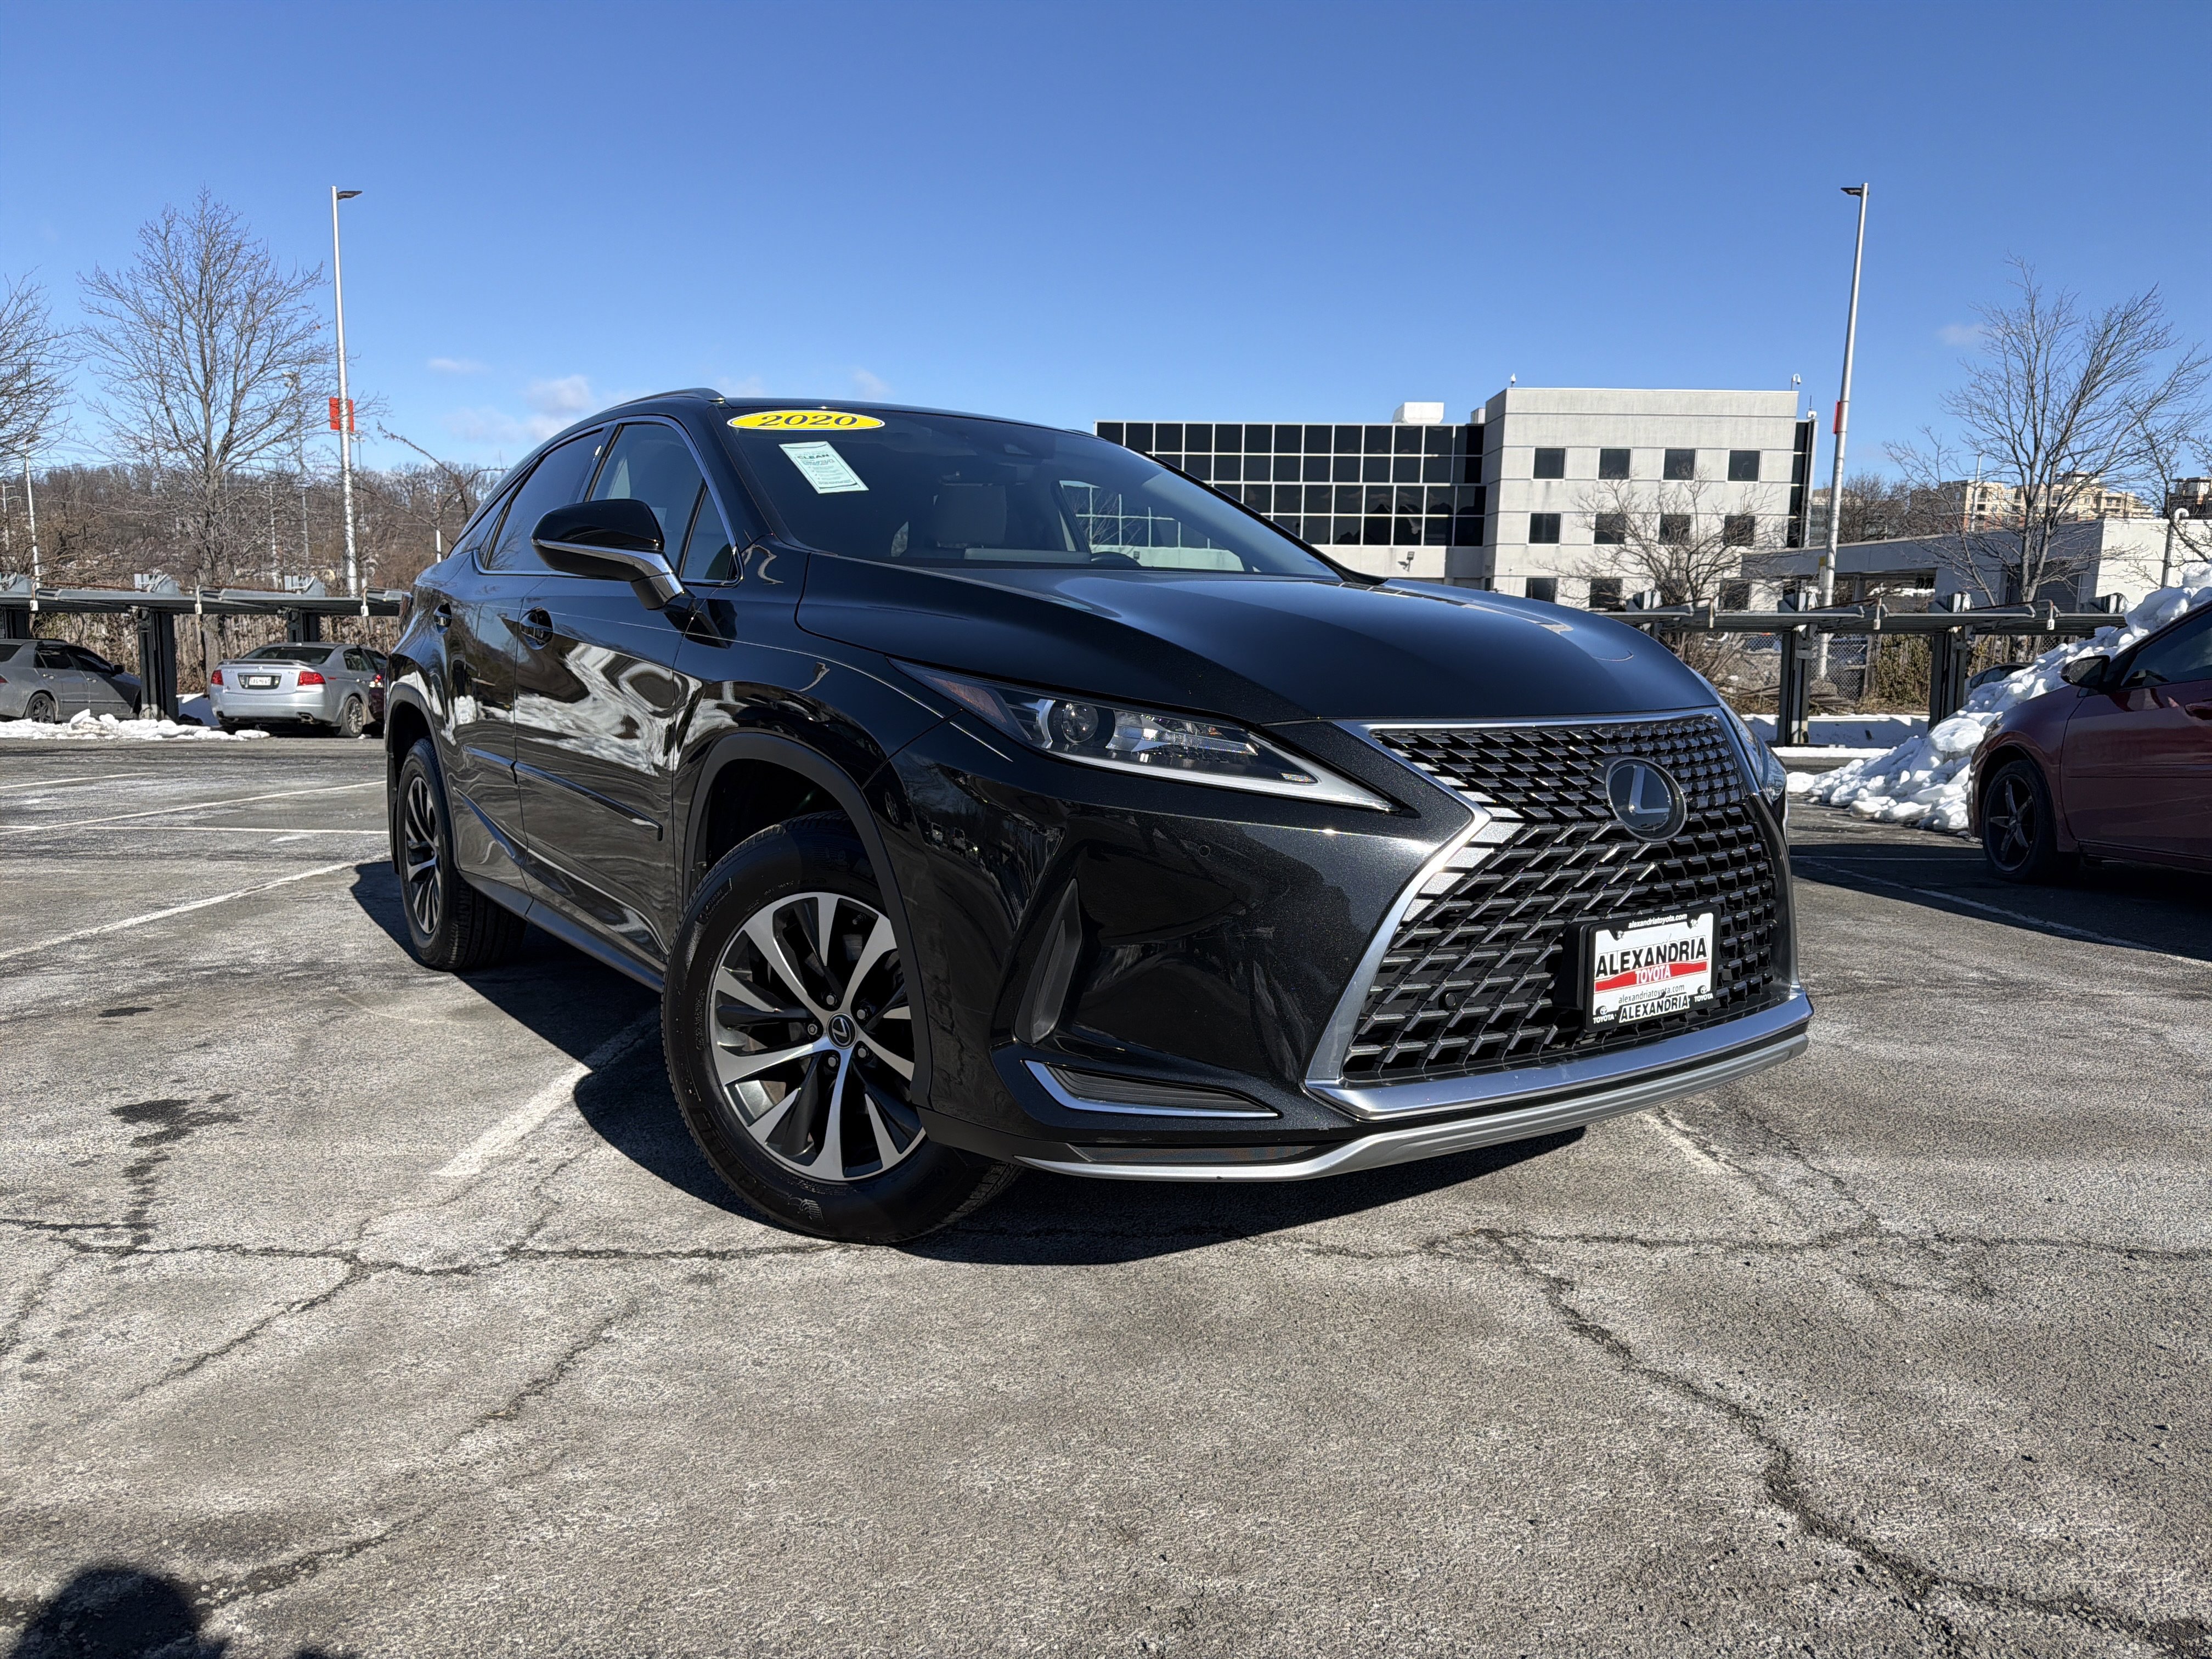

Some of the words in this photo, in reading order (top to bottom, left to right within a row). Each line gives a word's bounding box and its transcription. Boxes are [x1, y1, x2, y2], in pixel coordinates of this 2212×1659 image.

[757, 415, 857, 426] 2020
[1628, 913, 1687, 929] alexandriatoyota.com
[1595, 937, 1707, 978] ALEXANDRIA
[1635, 964, 1671, 984] TOYOTA
[1618, 984, 1685, 1004] alexandriatoyota.com
[1593, 1013, 1615, 1024] TOYOTA
[1620, 994, 1690, 1023] ALEXANDRIA
[1694, 993, 1713, 1003] TOYOTA
